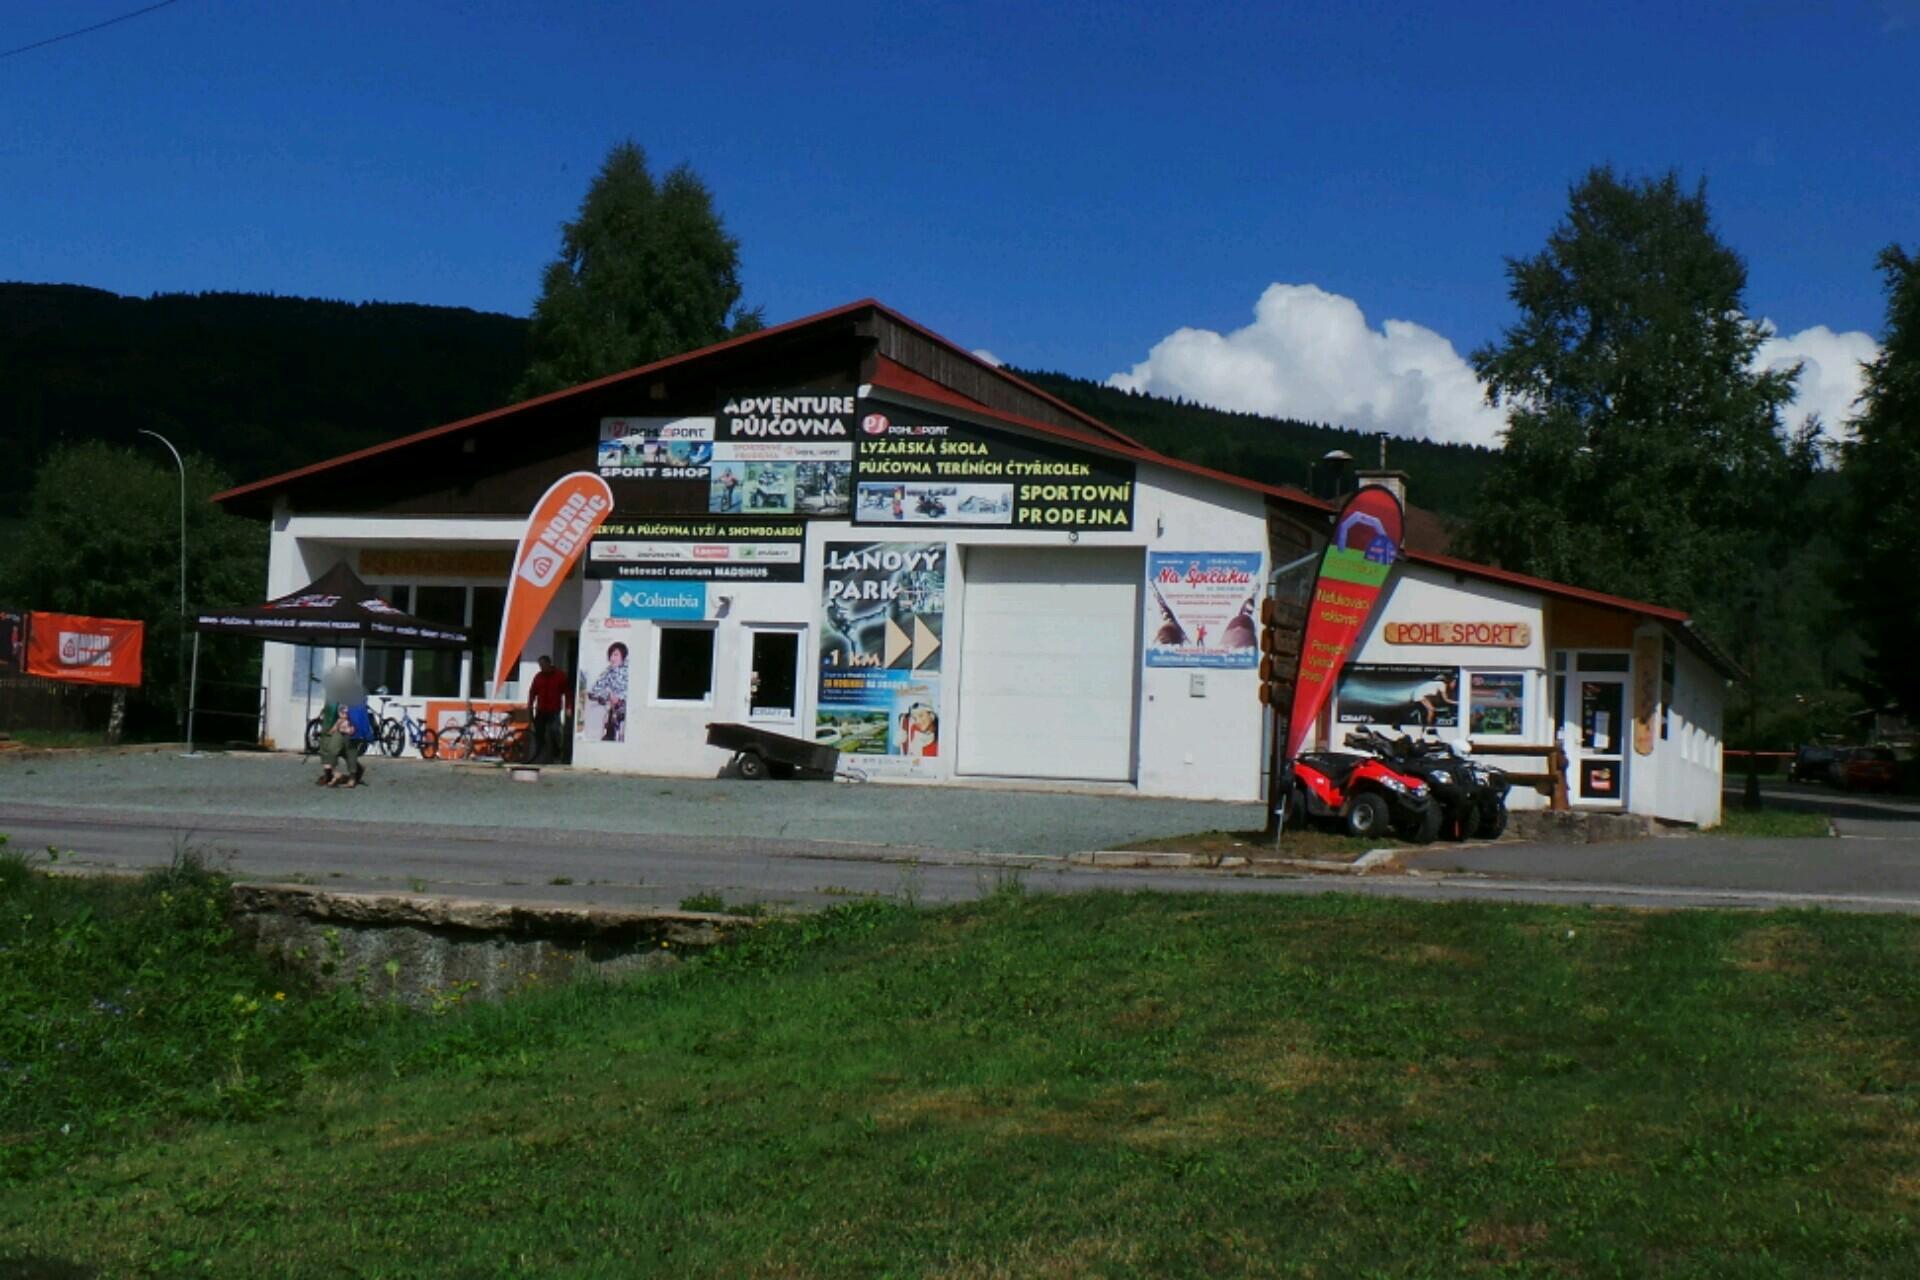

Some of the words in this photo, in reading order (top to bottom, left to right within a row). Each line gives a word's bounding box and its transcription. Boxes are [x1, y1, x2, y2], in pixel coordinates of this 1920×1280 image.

[723, 396, 855, 415] ADVENTURE
[730, 414, 847, 437] PŮJČOVNA
[860, 437, 936, 455] LYŽAŘSKÁ
[939, 439, 989, 456] ŠKOLA
[600, 467, 655, 478] SPORT
[661, 467, 710, 478] SHOP
[859, 459, 931, 474] PŮJČOVNA
[937, 459, 1002, 476] TERÉNÍCH
[1006, 459, 1091, 476] ČTYŘKOLEK
[1020, 480, 1131, 501] SPORTOVNÍ
[540, 490, 588, 546] NORD
[554, 493, 608, 557] BLANC
[1018, 507, 1129, 525] PRODEJNA
[628, 525, 635, 535] A
[719, 526, 726, 536] A
[830, 546, 940, 571] LANOVÝ
[669, 567, 712, 577] centrum
[829, 580, 900, 600] PARK
[633, 591, 699, 609] Columbia
[1397, 623, 1445, 643] POHL
[1451, 623, 1518, 644] SPORT
[830, 649, 839, 666] 1
